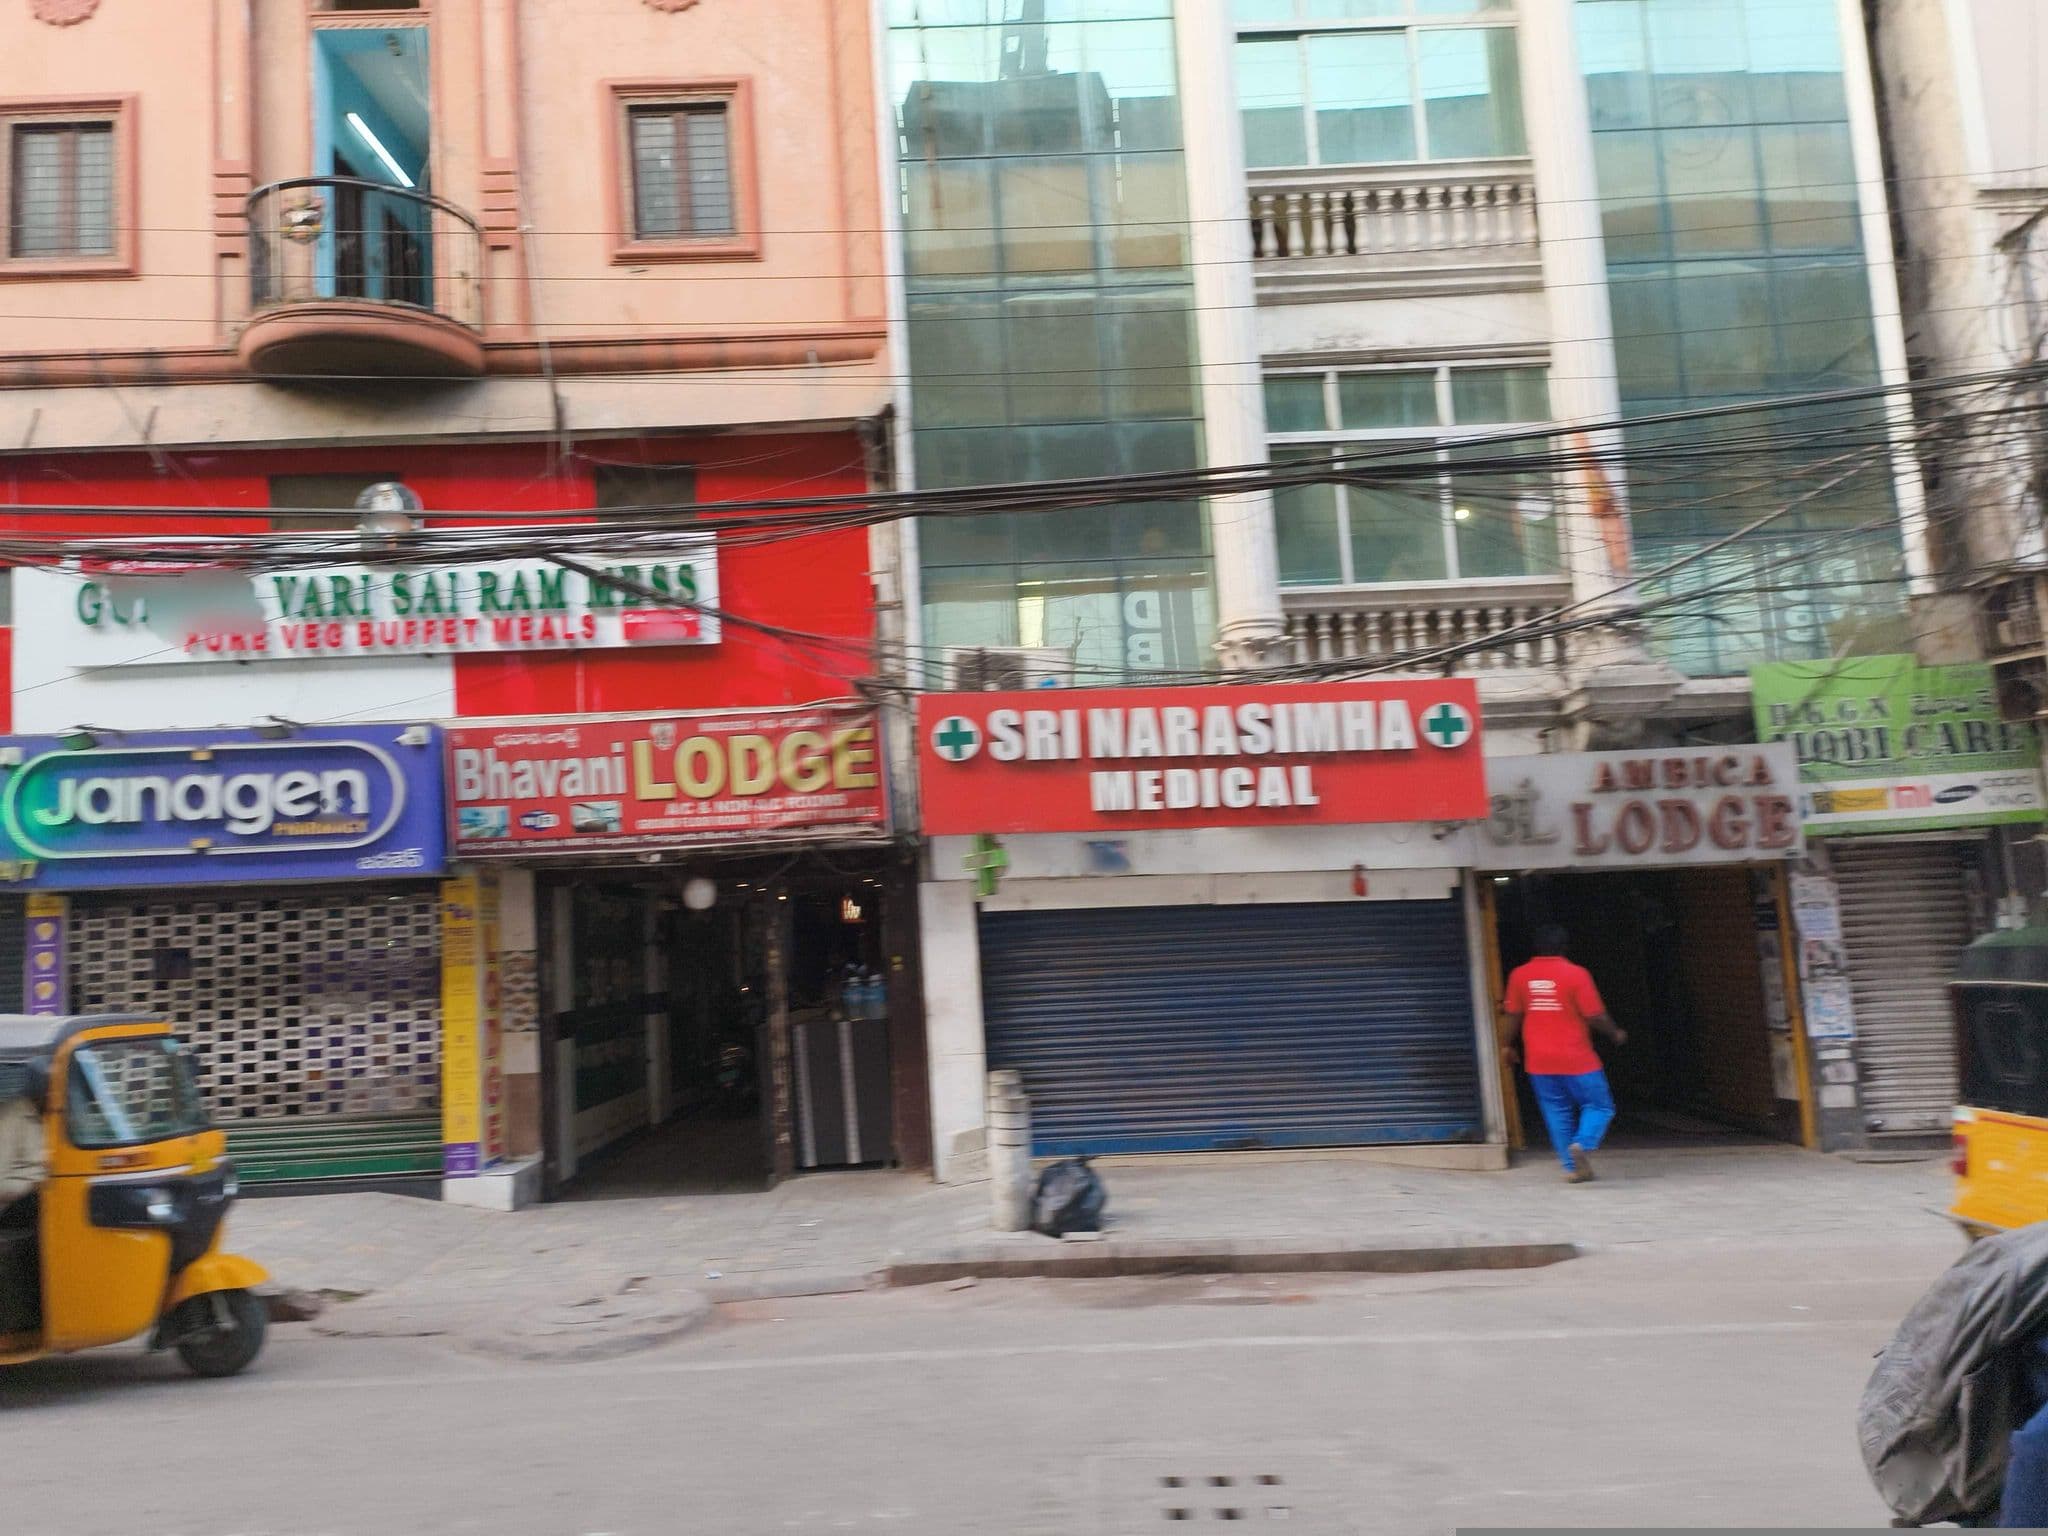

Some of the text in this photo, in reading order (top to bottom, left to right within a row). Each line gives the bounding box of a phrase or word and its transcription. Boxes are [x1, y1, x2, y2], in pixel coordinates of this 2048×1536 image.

[391, 572, 460, 616] SAI
[478, 567, 568, 613] RAM
[280, 622, 342, 650] VEG
[357, 617, 479, 648] BUFFET
[491, 613, 597, 643] MEALS
[987, 699, 1418, 762] SRI NARASIMHA
[453, 727, 879, 802] Bhavani LODGE
[1090, 765, 1320, 812] MEDICAL
[1590, 755, 1774, 794] AMBICA
[1569, 794, 1797, 856] LODGE
